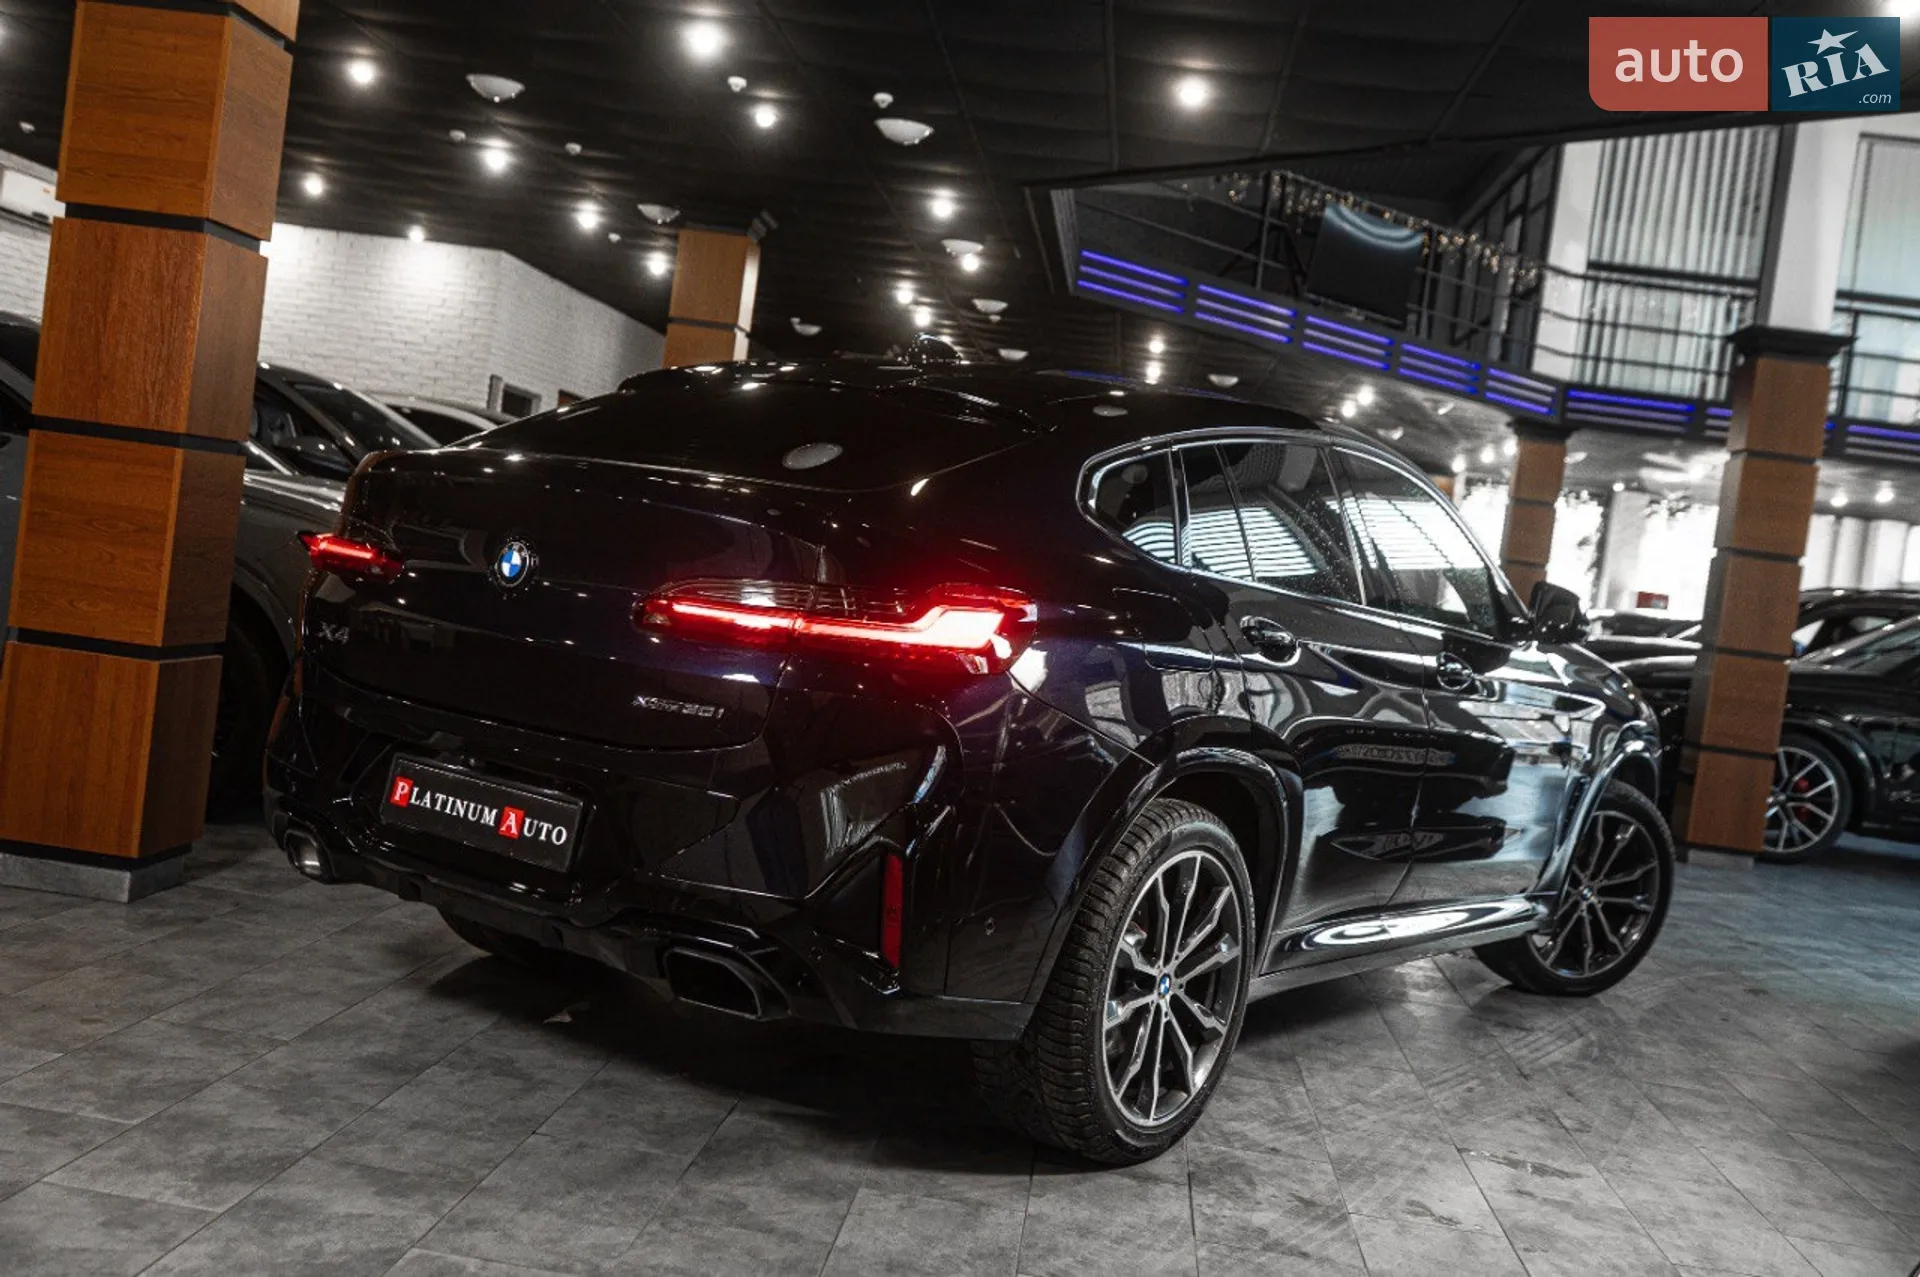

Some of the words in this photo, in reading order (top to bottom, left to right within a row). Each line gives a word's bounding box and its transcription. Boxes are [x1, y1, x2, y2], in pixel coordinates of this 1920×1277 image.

[318, 621, 350, 644] X4
[393, 781, 498, 825] PLATINUM
[500, 811, 568, 845] AUTO
